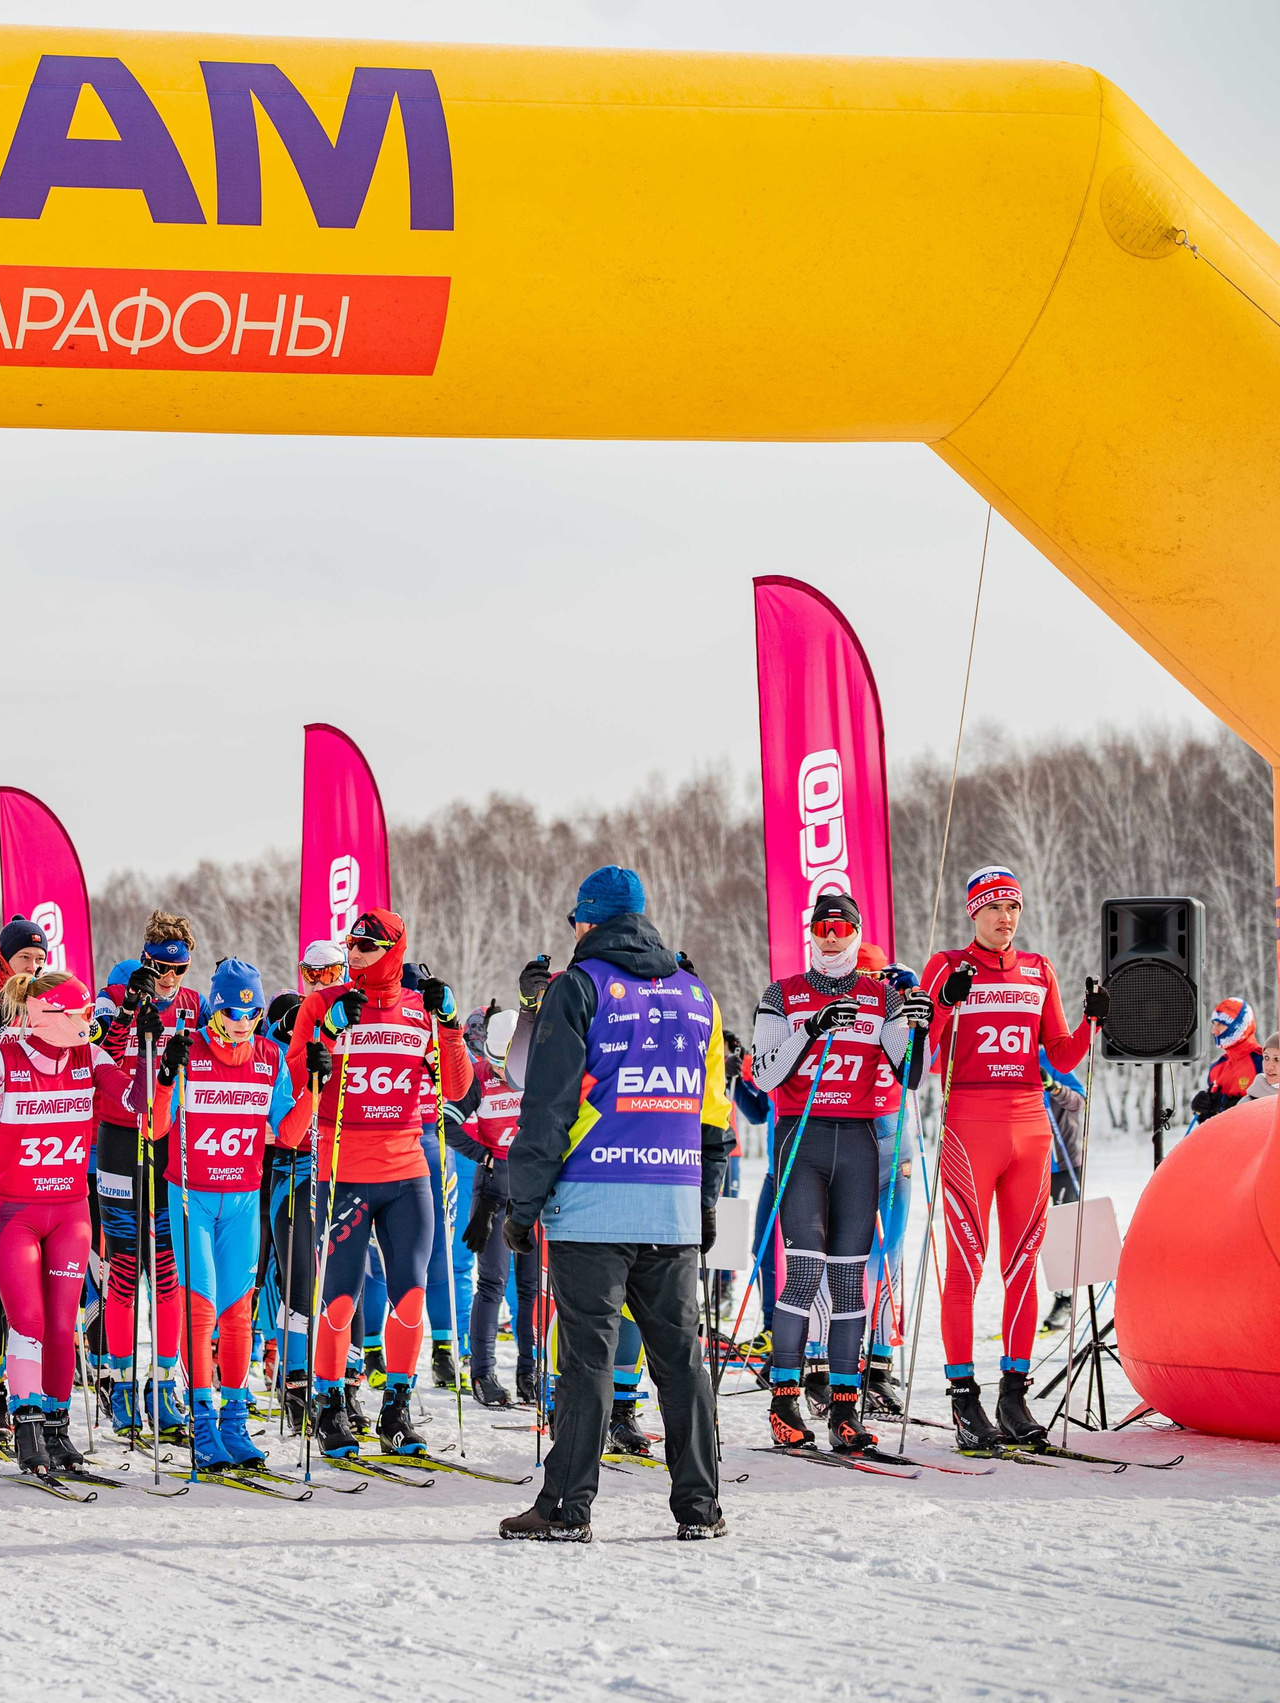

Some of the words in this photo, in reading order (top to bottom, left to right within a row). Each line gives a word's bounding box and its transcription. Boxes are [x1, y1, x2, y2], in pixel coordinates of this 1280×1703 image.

[339, 1031, 422, 1048] ТЕМЕРСО
[976, 1025, 1031, 1054] 261
[797, 1053, 864, 1082] 427
[987, 1064, 1025, 1072] ТЕМЕРСО
[346, 1066, 413, 1095] 364
[617, 1066, 701, 1095] БАМ
[194, 1089, 269, 1106] ТЕМЕРСО
[810, 1091, 852, 1099] ЕМЕРСО
[16, 1097, 92, 1115] ТЕМЕРСО
[631, 1099, 693, 1111] МАРАФОНЫ
[194, 1127, 258, 1157] 467
[18, 1136, 86, 1166] 324
[590, 1147, 702, 1167] ОРГКОМИТЕ
[206, 1167, 245, 1175] ТЕМЕРСО
[209, 1173, 242, 1181] АНГАРА
[32, 1177, 74, 1185] ТЕМЕРСО
[101, 1187, 131, 1198] GAZPROM
[960, 1221, 976, 1246] CRAFT
[1026, 1225, 1043, 1251] CRAFT
[399, 1457, 423, 1466] FISCHER
[205, 1475, 224, 1484] FISCHER
